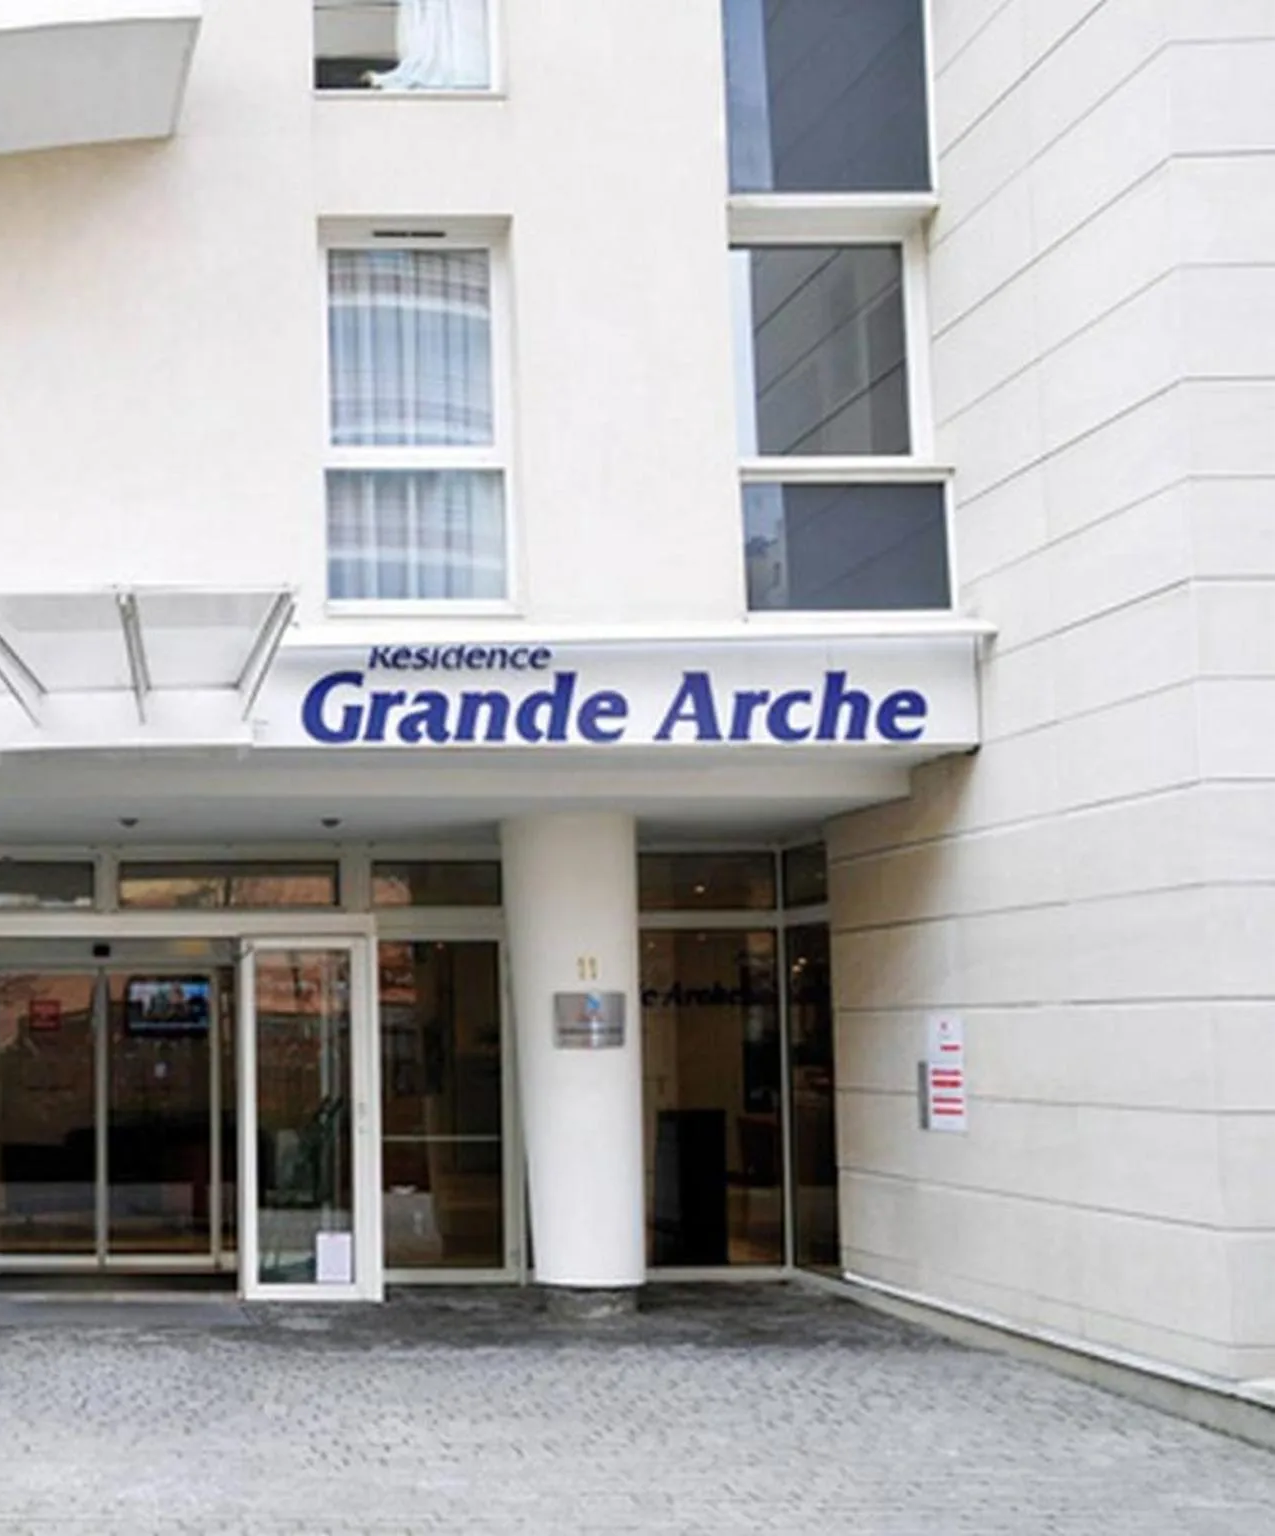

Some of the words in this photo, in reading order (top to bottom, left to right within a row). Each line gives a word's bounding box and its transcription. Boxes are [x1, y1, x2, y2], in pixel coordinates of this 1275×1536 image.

[301, 670, 629, 744] Grande
[653, 670, 927, 743] Arche
[576, 955, 599, 981] 11
